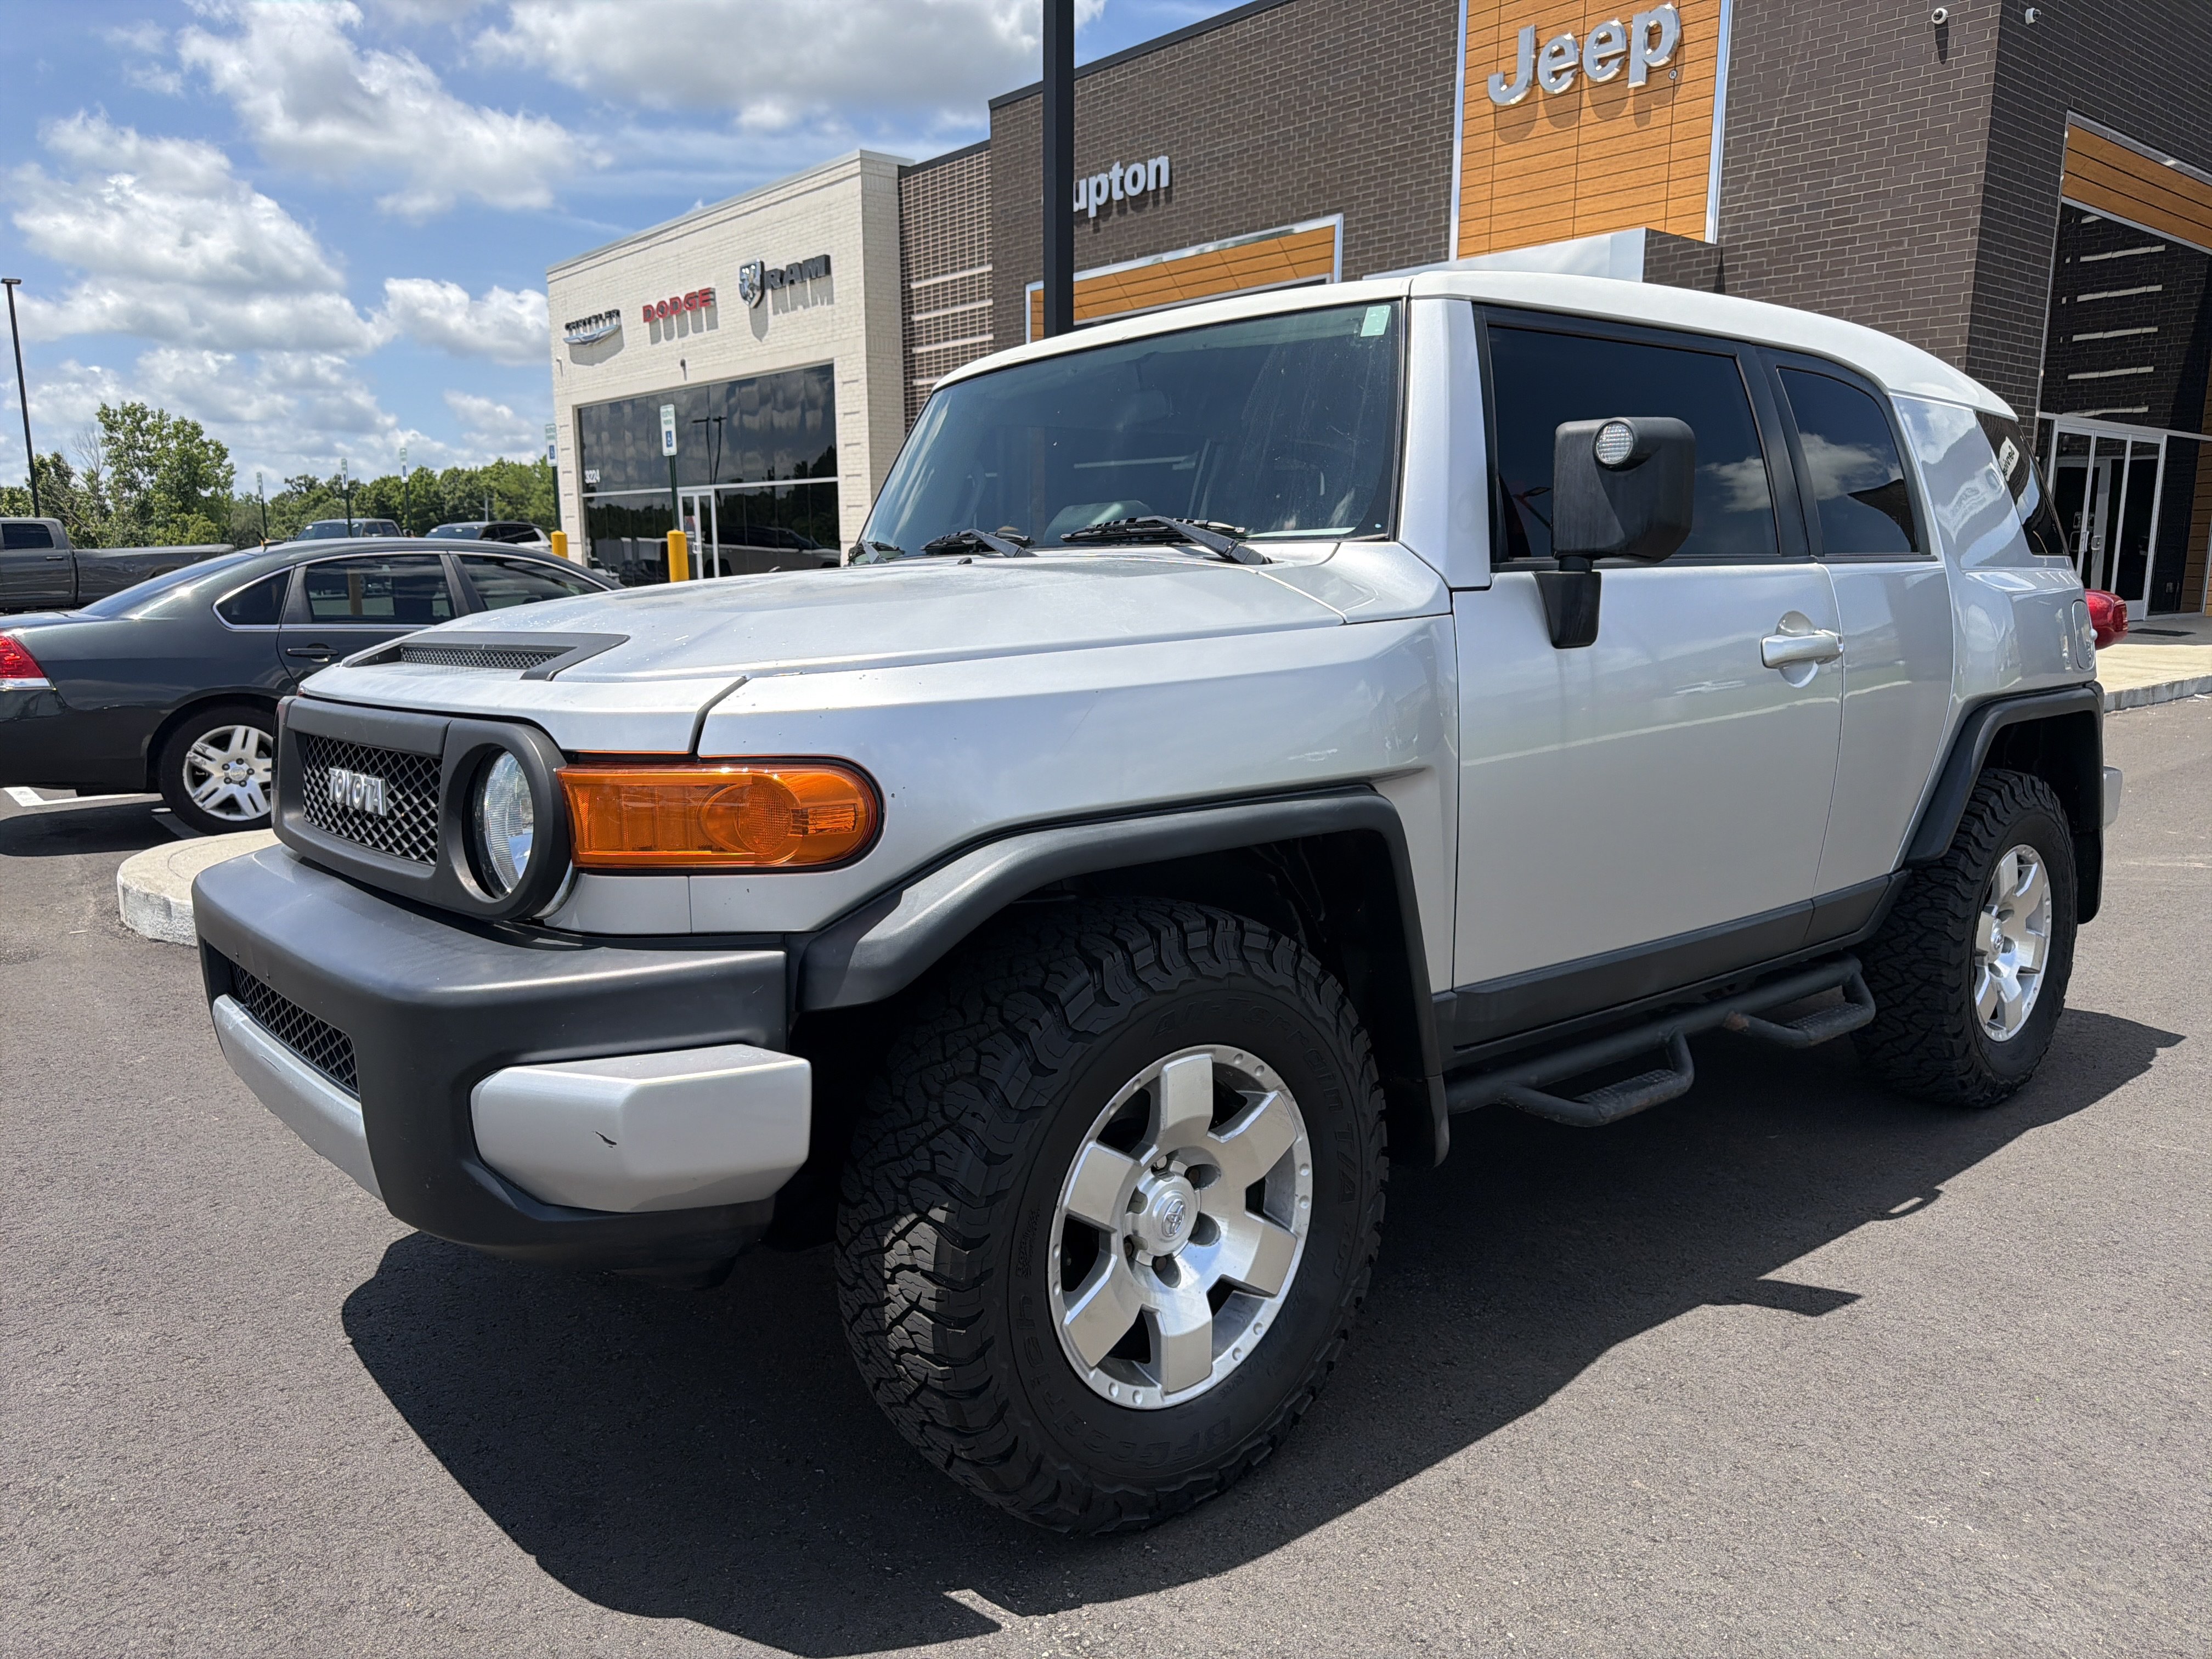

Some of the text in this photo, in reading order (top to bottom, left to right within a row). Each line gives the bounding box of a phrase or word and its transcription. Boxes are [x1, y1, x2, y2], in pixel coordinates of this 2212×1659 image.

[1487, 3, 1681, 106] Jeep
[1074, 155, 1169, 218] upton
[765, 254, 831, 290] RAM
[642, 287, 714, 323] DODGE
[585, 469, 600, 484] 3224
[329, 768, 386, 816] TOYOTA
[1151, 996, 1344, 1115] All-Terrain
[1334, 1120, 1357, 1204] T/A
[1015, 1294, 1232, 1469] BFGoodrich
